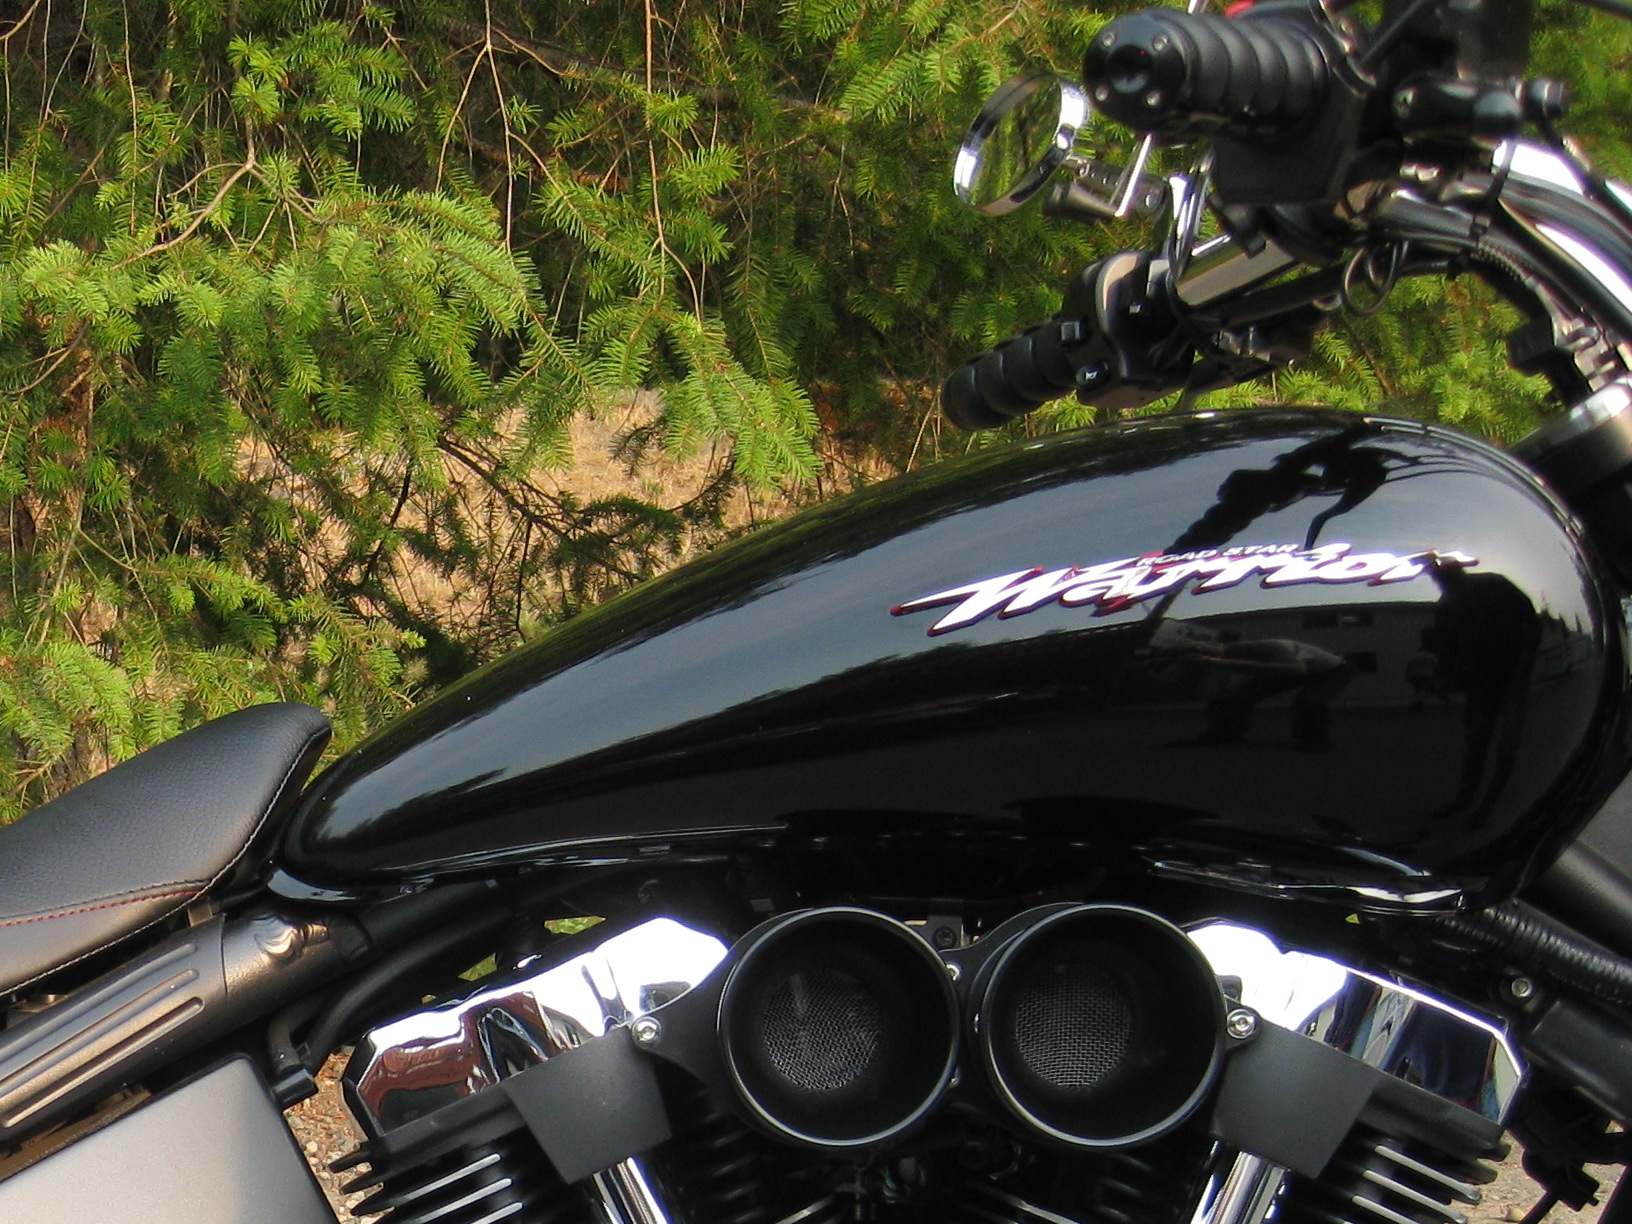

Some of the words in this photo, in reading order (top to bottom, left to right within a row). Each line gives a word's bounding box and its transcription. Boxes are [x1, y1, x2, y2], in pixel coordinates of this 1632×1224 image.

[1136, 548, 1216, 567] ROAD
[1221, 542, 1299, 558] STAR
[890, 543, 1479, 636] Warrior
